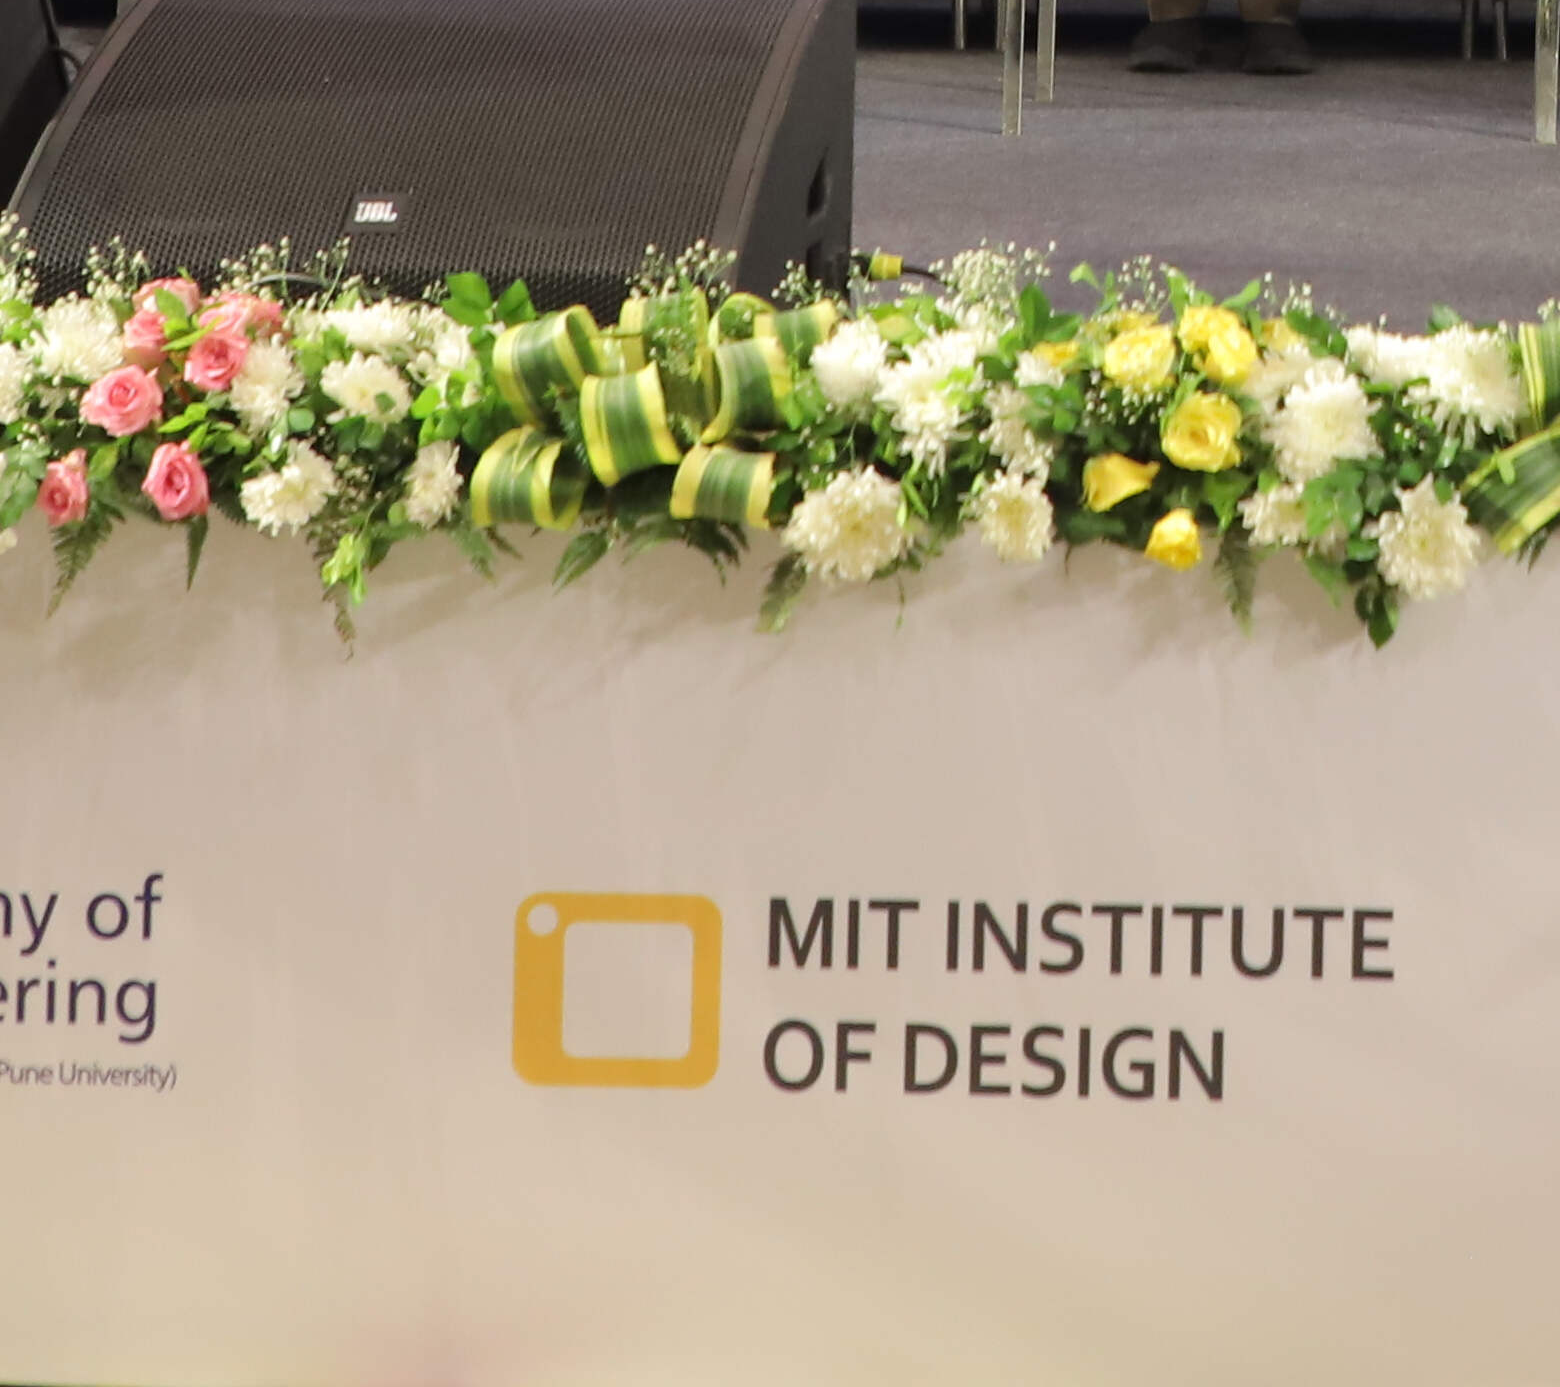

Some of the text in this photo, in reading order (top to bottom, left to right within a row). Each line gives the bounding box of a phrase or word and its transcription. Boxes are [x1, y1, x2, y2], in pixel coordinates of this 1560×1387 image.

[86, 871, 164, 940] of
[766, 897, 1395, 981] MIT INSTITUTE
[59, 1060, 177, 1093] University)
[762, 1018, 1226, 1101] OF DESIGN
